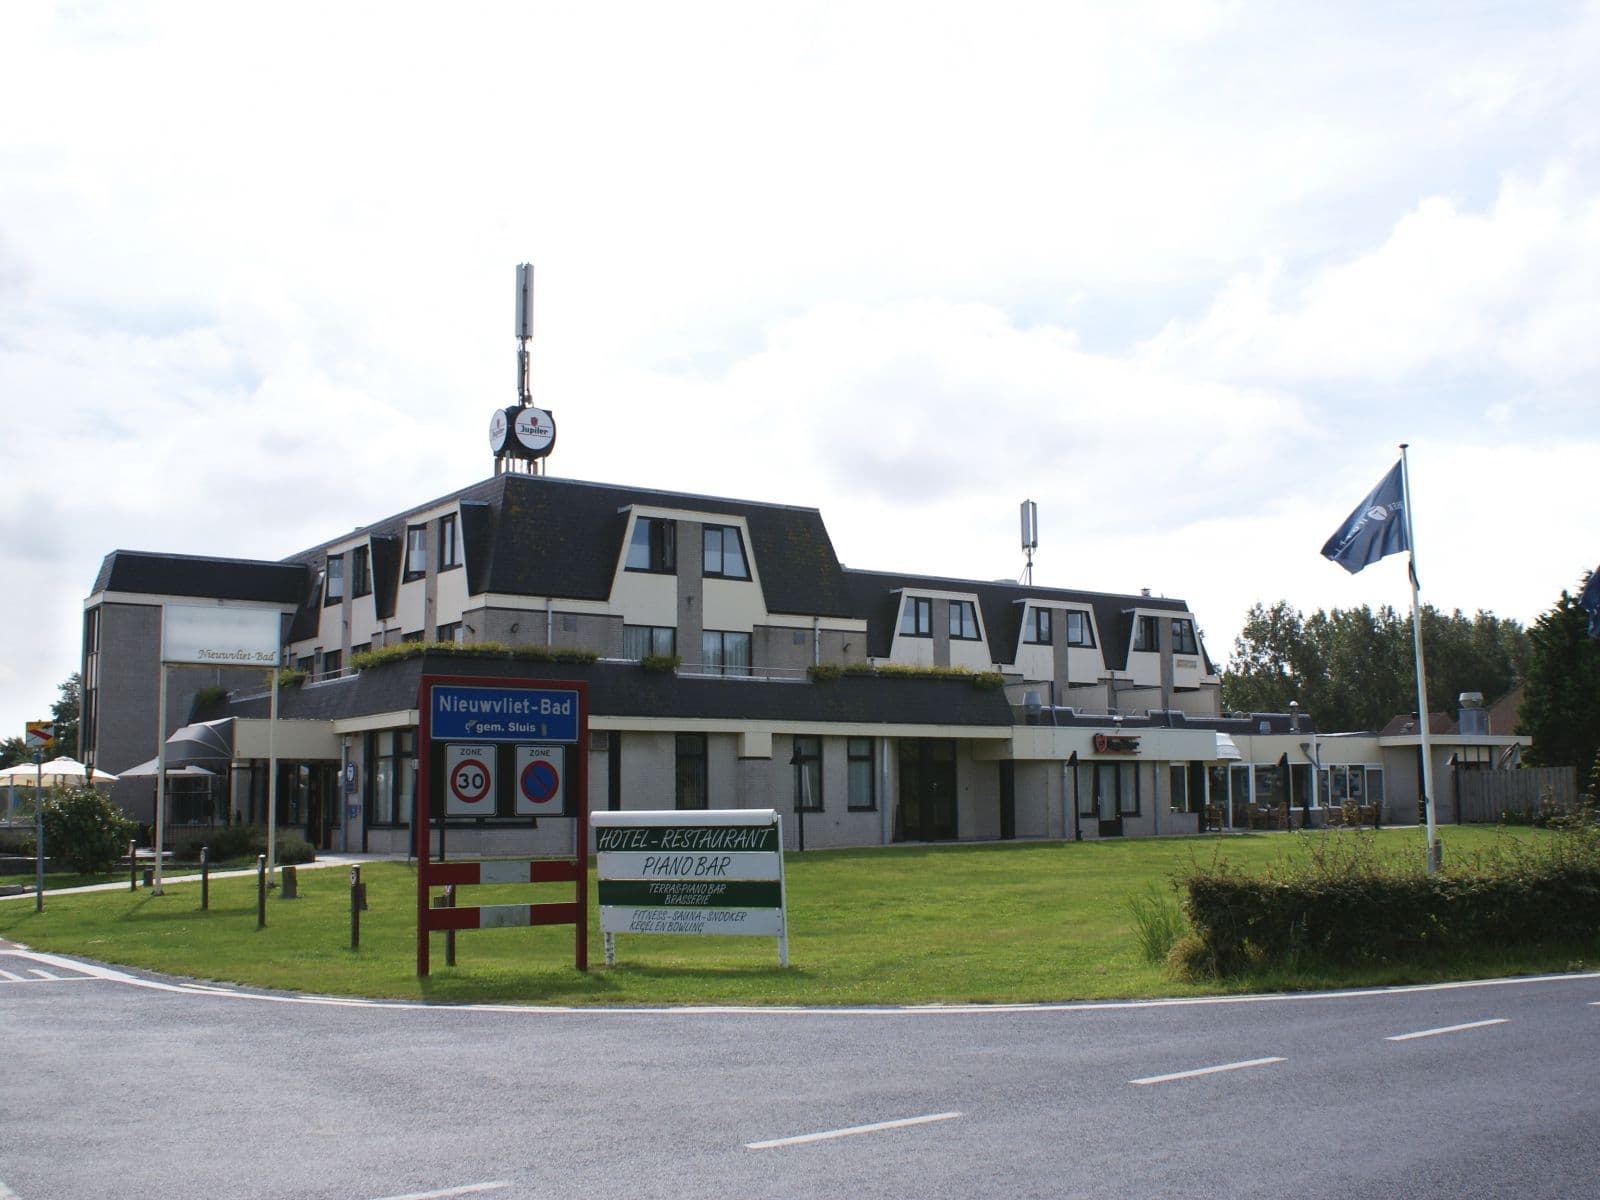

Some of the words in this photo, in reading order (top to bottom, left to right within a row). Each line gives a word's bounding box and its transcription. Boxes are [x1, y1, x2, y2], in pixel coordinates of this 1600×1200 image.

[439, 695, 571, 715] Nieuwvliet-Bad
[476, 722, 504, 733] gem.
[508, 722, 536, 732] Sluis
[460, 748, 482, 756] ZONE
[529, 749, 551, 757] ZONE
[458, 773, 484, 789] 30
[642, 856, 693, 876] PIANO
[695, 856, 731, 876] BAR
[708, 883, 727, 895] BAR
[664, 894, 711, 905] BRASSERIE
[629, 921, 655, 932] KEGEL
[655, 922, 666, 931] EN
[667, 922, 705, 934] BOWLING
